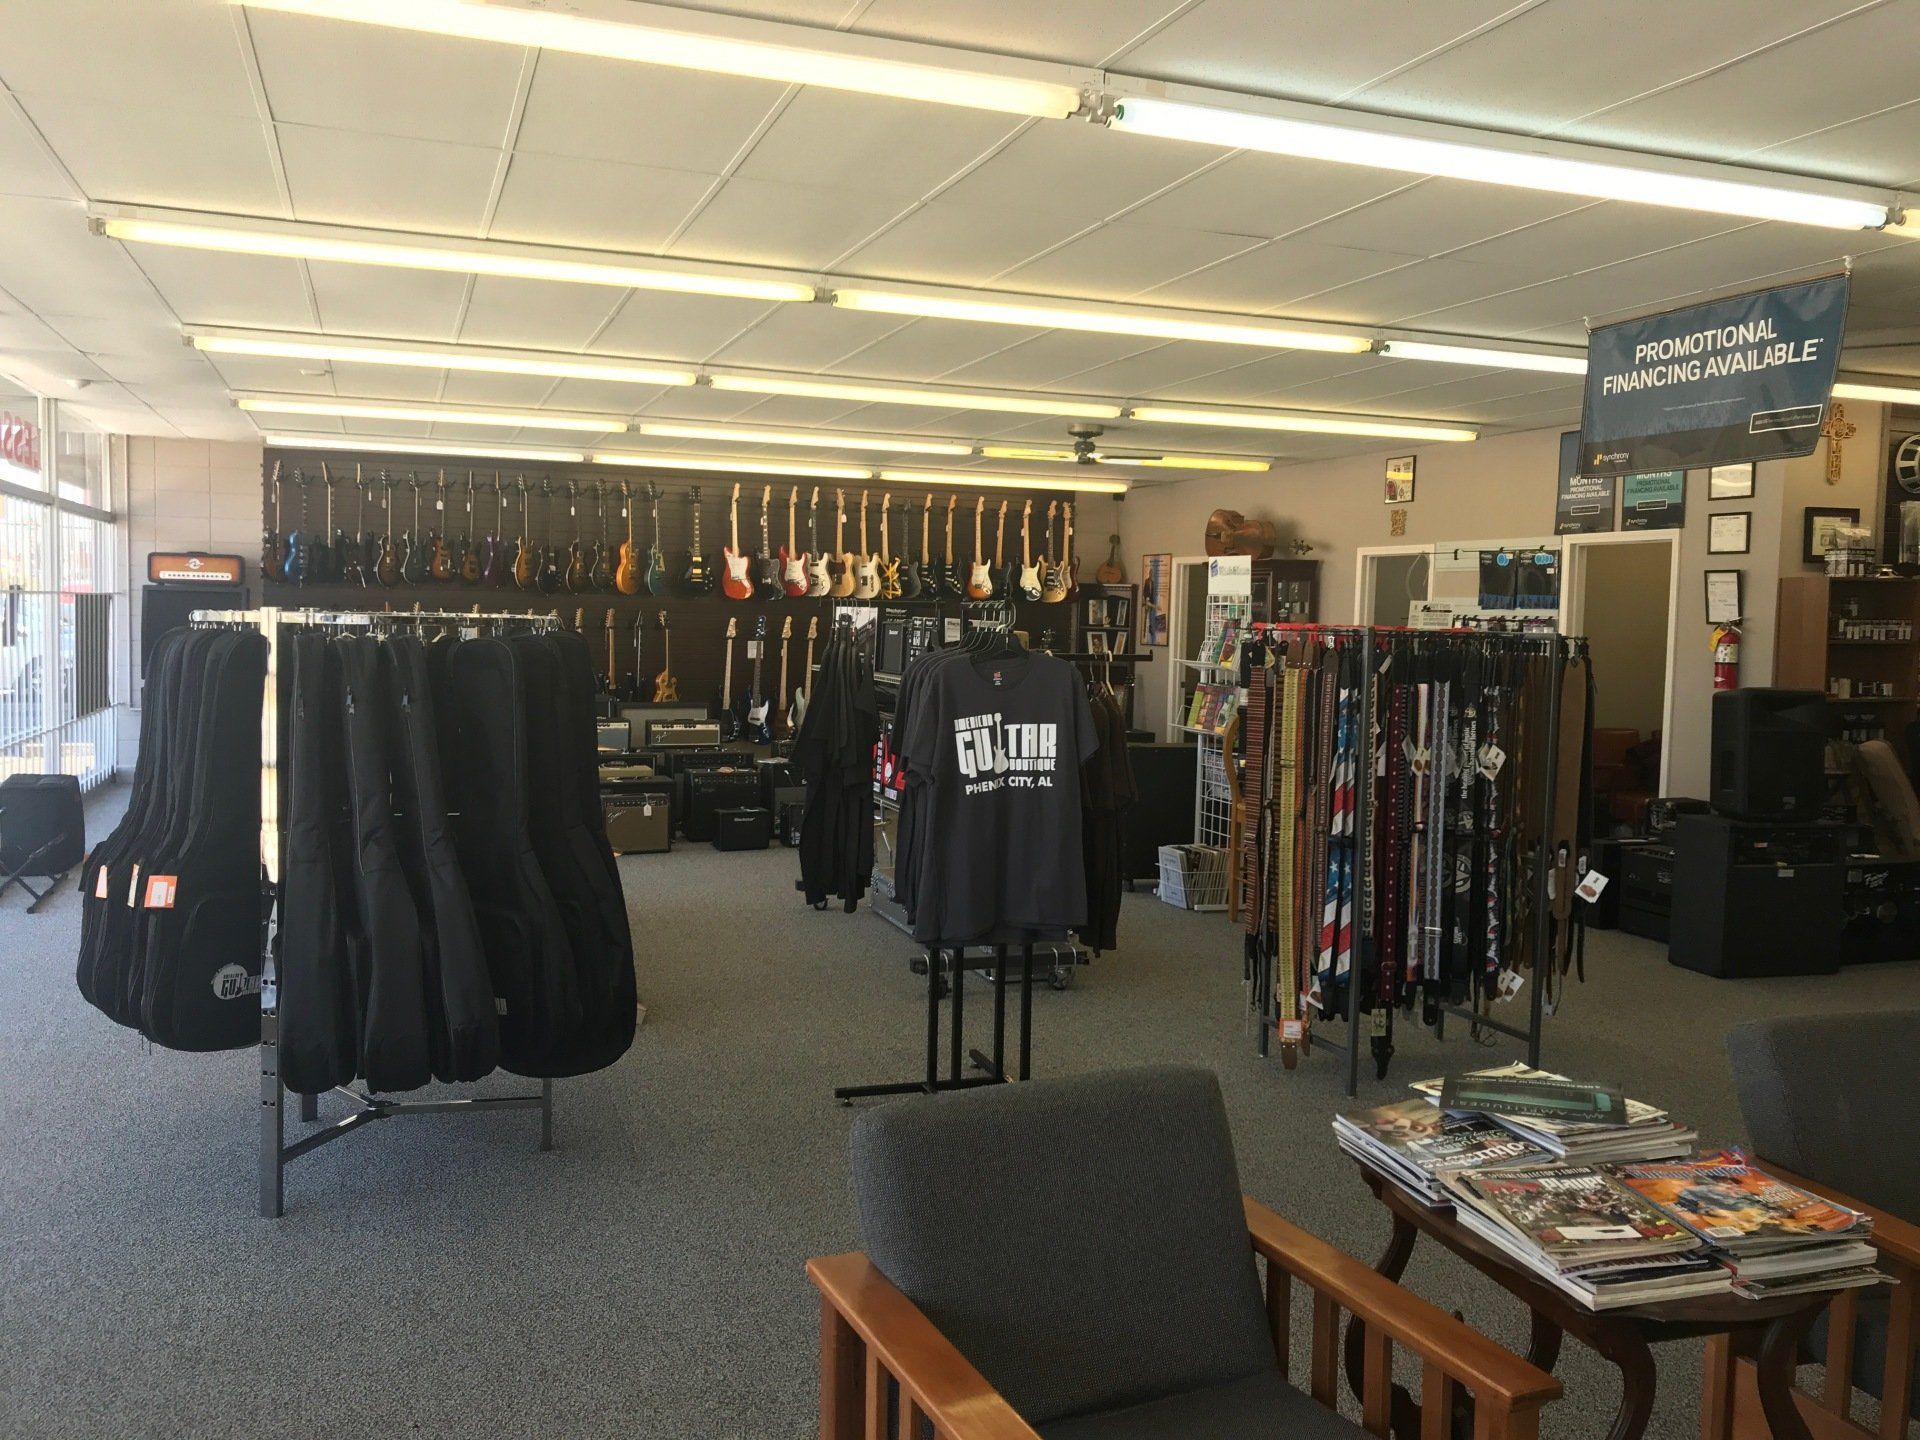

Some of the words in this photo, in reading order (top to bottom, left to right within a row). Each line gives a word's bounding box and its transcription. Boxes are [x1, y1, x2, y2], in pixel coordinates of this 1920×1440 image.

[1635, 317, 1777, 364] PROMOTIONAL
[1602, 359, 1701, 396] FINANCING
[1570, 485, 1603, 494] PROMOTIONAL
[1626, 486, 1653, 494] FINANCING
[1653, 483, 1680, 492] AVAILABLE
[1636, 478, 1671, 487] PROMOTIONAL
[1561, 493, 1585, 501] FINANCING
[1586, 490, 1610, 498] AVAILABLE
[954, 713, 994, 732] AMERICAN
[965, 777, 1005, 796] PHENIX
[1007, 776, 1035, 789] CITY,
[1037, 776, 1053, 787] AL
